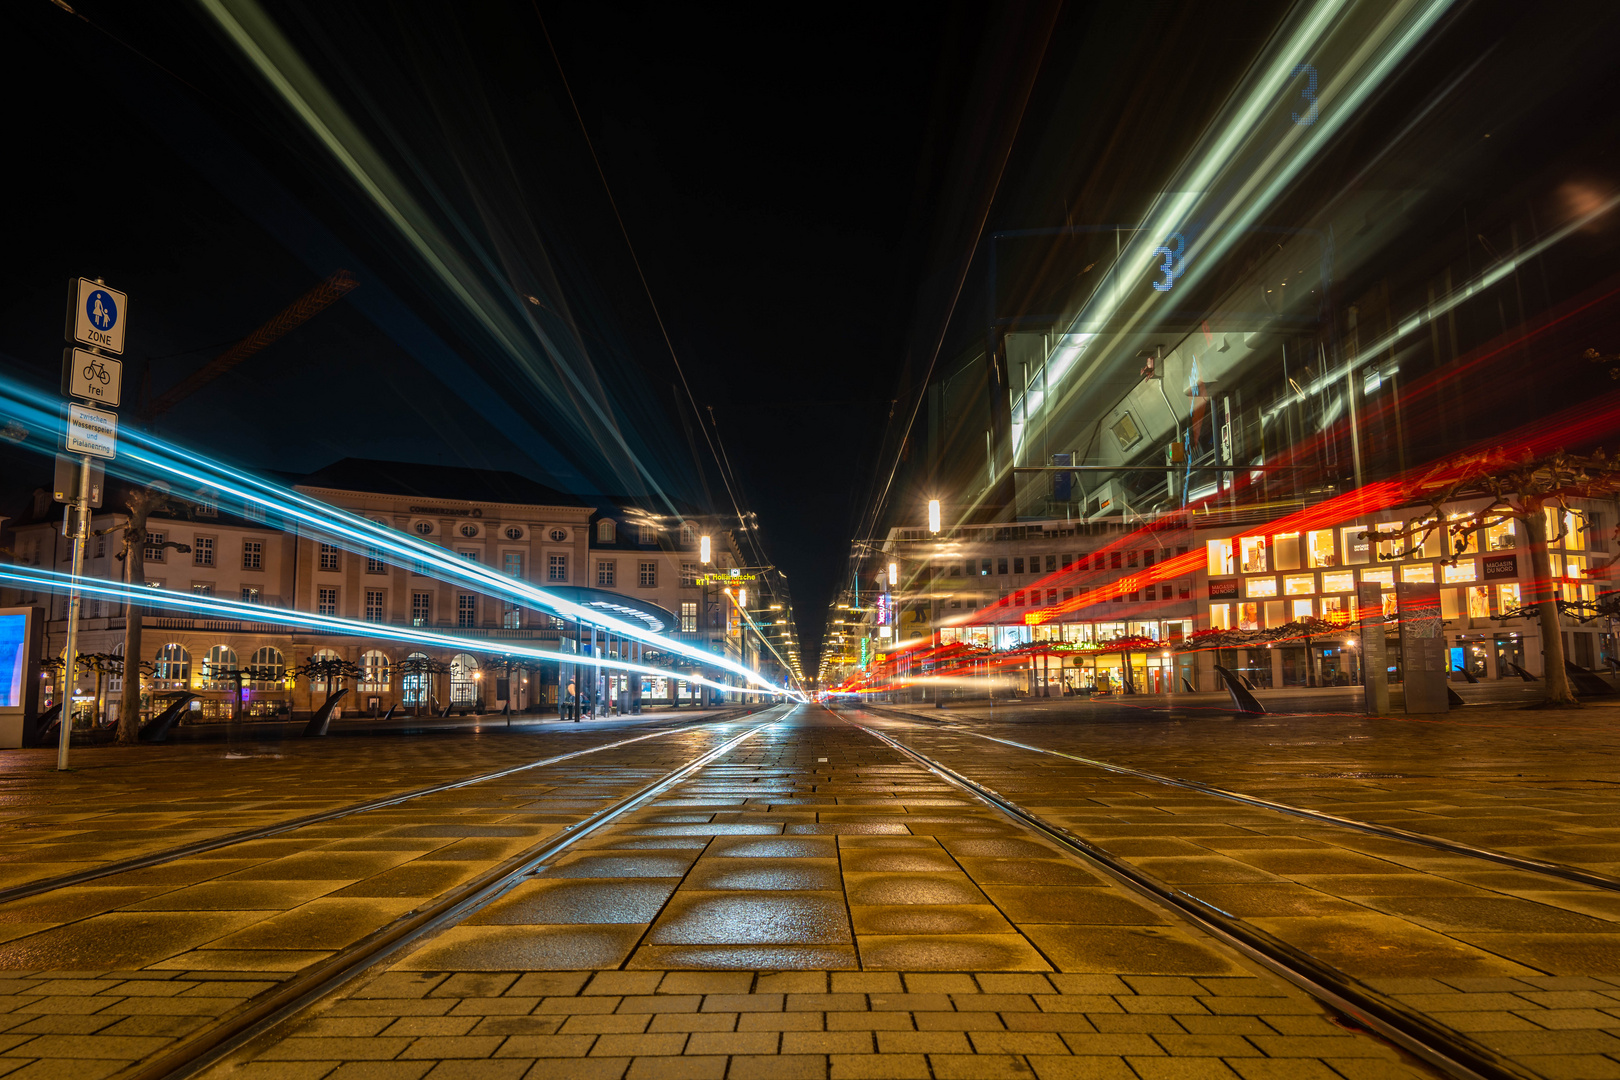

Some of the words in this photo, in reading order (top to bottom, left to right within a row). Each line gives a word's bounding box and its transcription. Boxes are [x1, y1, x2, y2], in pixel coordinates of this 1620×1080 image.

[1152, 246, 1173, 292] 3
[88, 329, 112, 346] ZONE
[88, 383, 104, 397] frei
[79, 412, 108, 425] zwischen
[72, 418, 113, 435] Wasserspeier
[86, 433, 98, 441] und
[409, 505, 471, 517] COMMERZBANK
[1496, 565, 1514, 573] NORD
